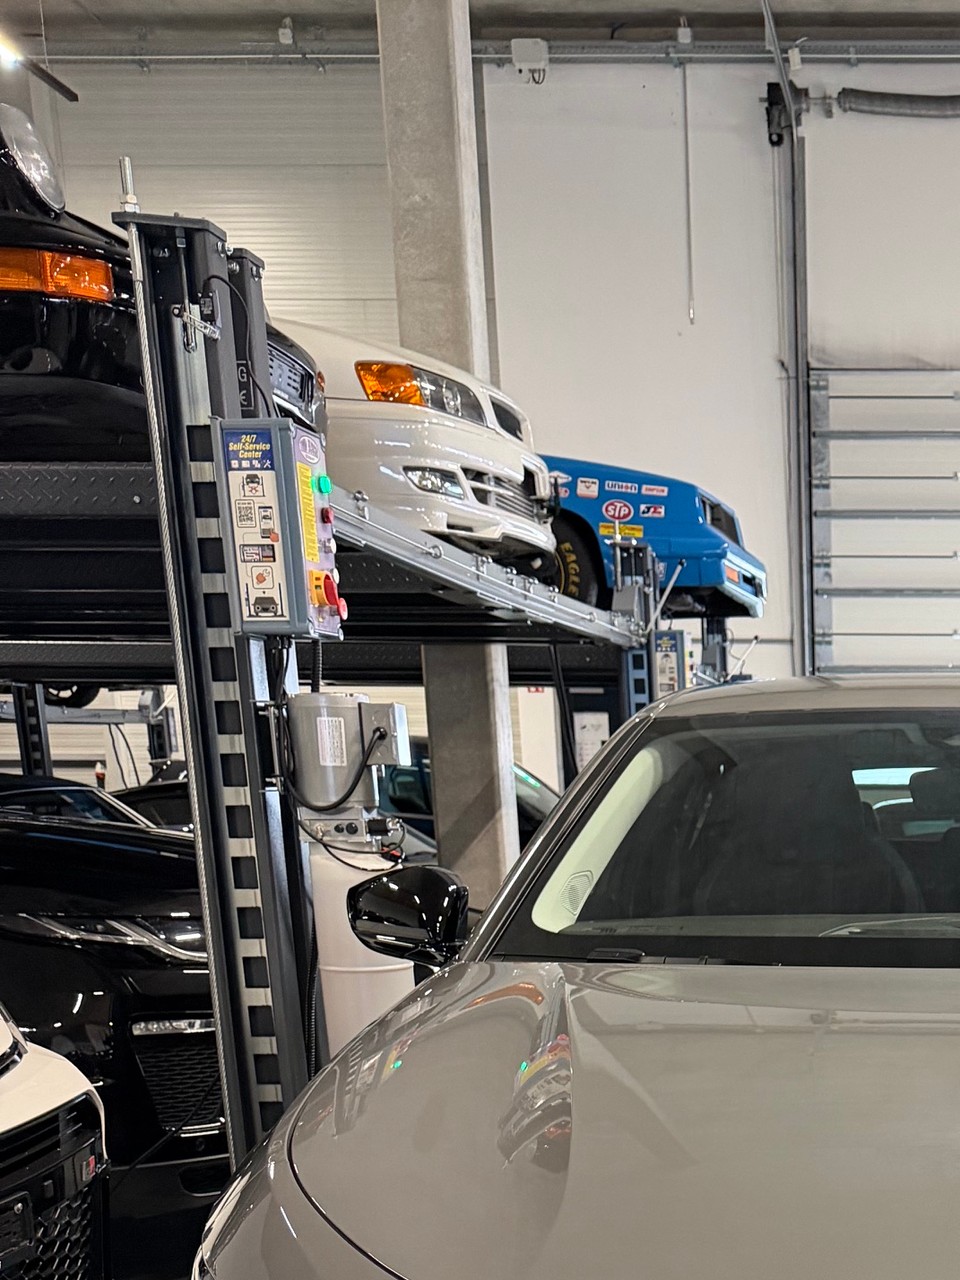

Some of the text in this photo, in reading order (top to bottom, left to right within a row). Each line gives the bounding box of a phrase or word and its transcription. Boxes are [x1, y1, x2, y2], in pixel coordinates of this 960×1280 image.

[241, 434, 257, 443] 24/7
[228, 442, 271, 451] Self-Service
[239, 450, 262, 459] Center
[607, 502, 629, 518] STP
